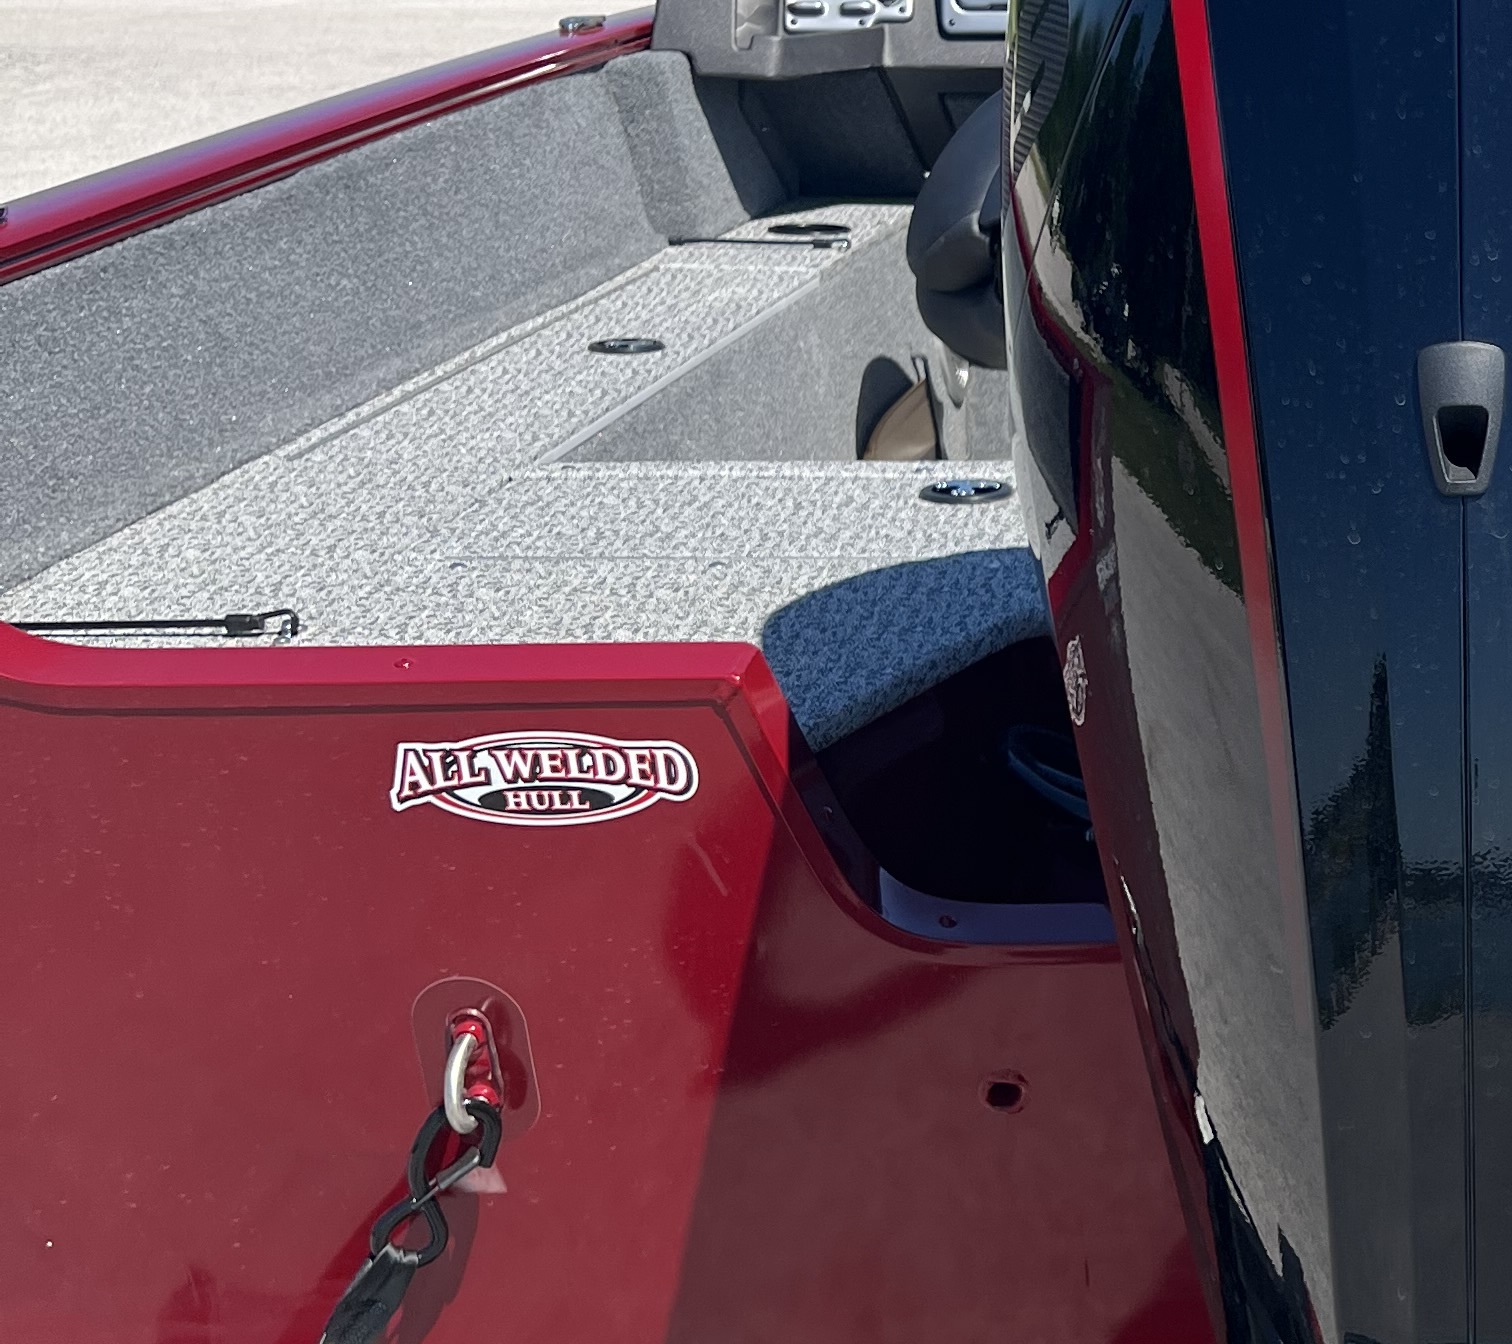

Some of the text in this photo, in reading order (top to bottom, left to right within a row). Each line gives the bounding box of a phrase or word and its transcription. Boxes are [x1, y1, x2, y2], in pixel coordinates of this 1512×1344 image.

[398, 747, 691, 799] ALL WELDED
[502, 790, 592, 811] HULL
